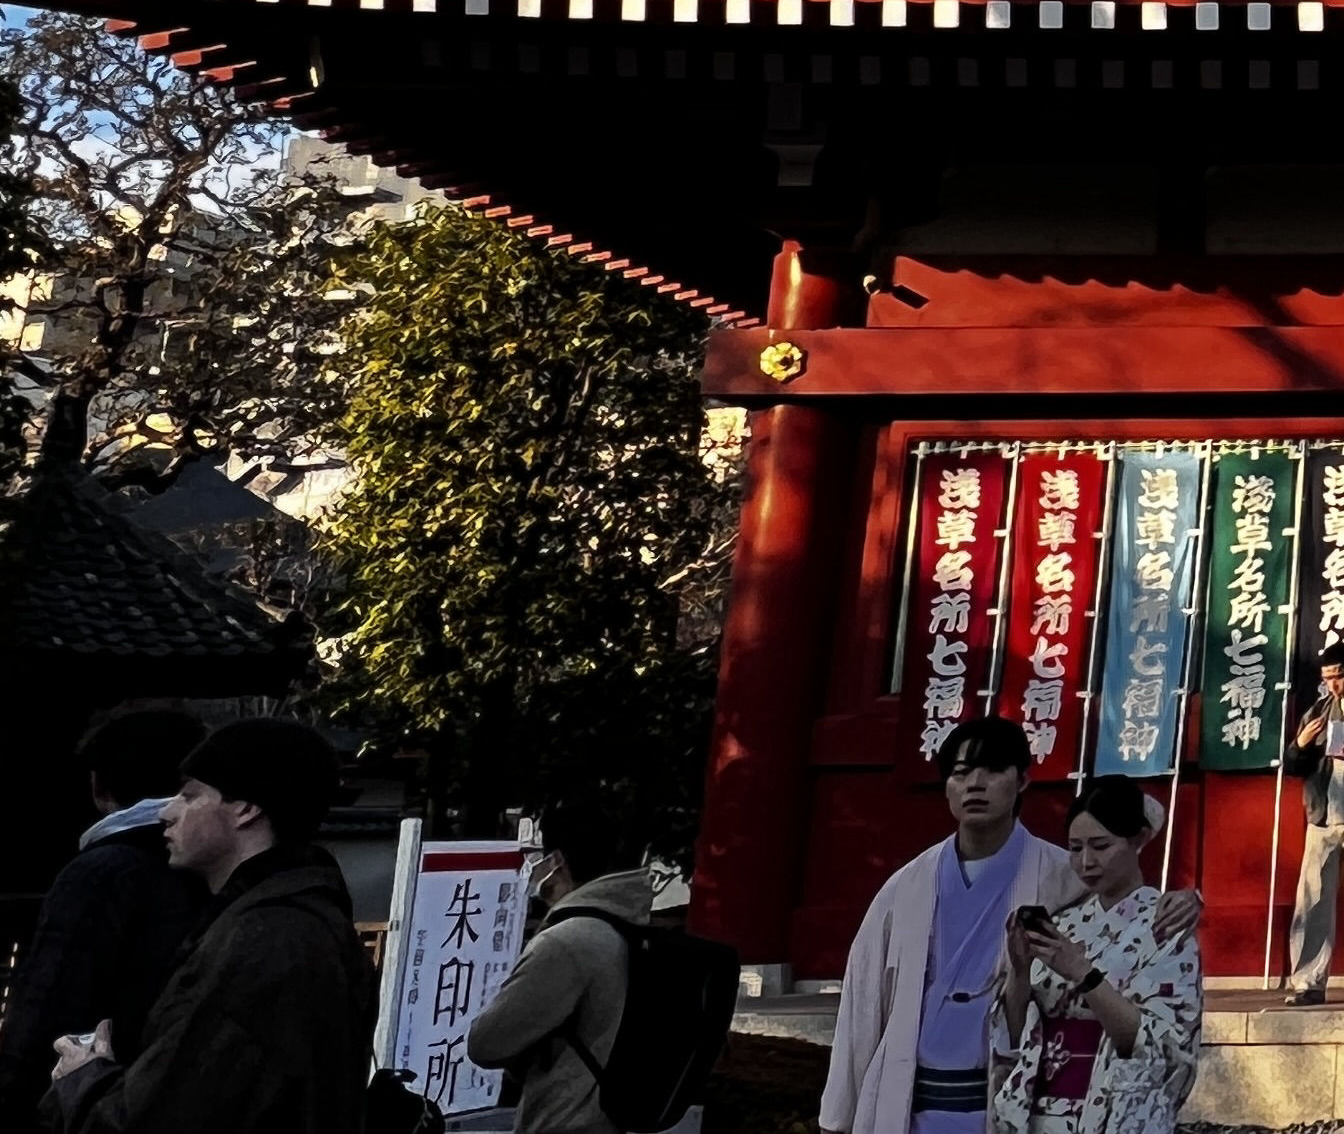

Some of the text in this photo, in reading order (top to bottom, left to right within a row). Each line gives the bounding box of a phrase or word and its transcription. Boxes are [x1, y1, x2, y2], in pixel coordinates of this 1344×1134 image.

[1021, 468, 1081, 765] 浅草名所七福神
[1117, 468, 1180, 762] 浅草名所七福神
[424, 878, 482, 1106] 朱印所
